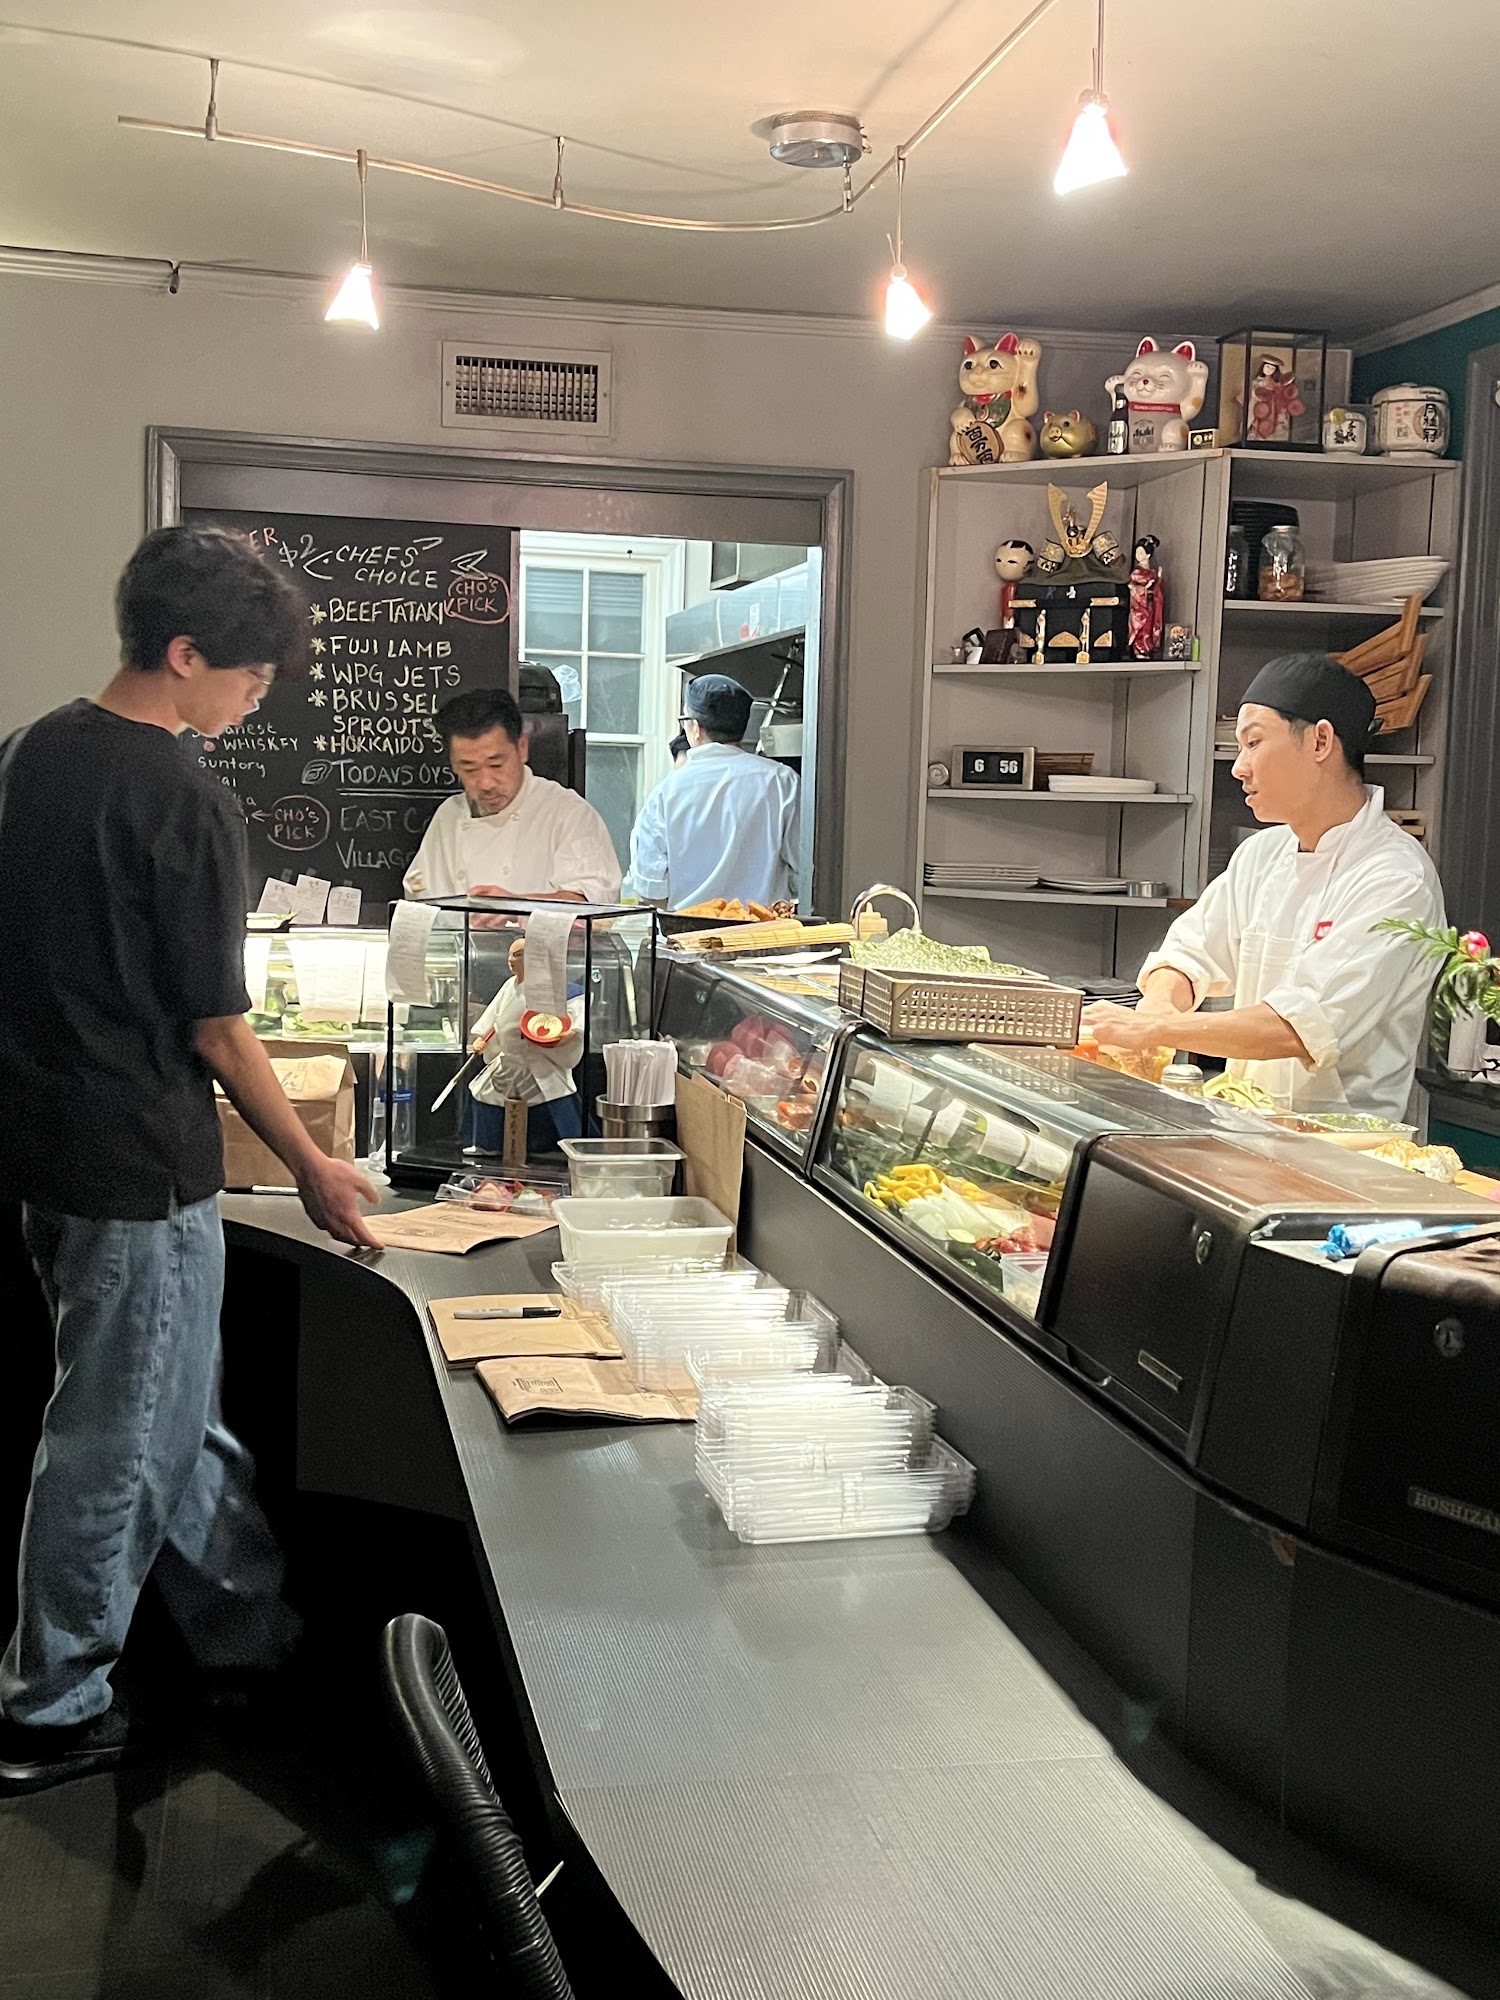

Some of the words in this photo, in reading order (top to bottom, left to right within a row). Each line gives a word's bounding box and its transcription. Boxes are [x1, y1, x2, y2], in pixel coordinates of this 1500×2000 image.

[336, 545, 418, 568] CHEFS
[355, 568, 438, 589] CHOICE
[456, 578, 499, 595] CHO'S
[329, 597, 382, 622] BEEF
[381, 597, 443, 624] TATAKI
[457, 597, 498, 613] PICK
[329, 635, 378, 655] FUJI
[387, 639, 452, 659] LAMB
[331, 662, 383, 687] WPG
[394, 665, 461, 689] JETS
[333, 688, 439, 714] BRUSSEL
[333, 715, 438, 738] SPROUTS
[331, 759, 414, 785] TODAYS
[974, 758, 985, 773] 6
[1000, 759, 1018, 774] 56
[274, 807, 320, 823] CHO'S
[340, 805, 397, 831] EAST
[274, 824, 316, 839] PICK
